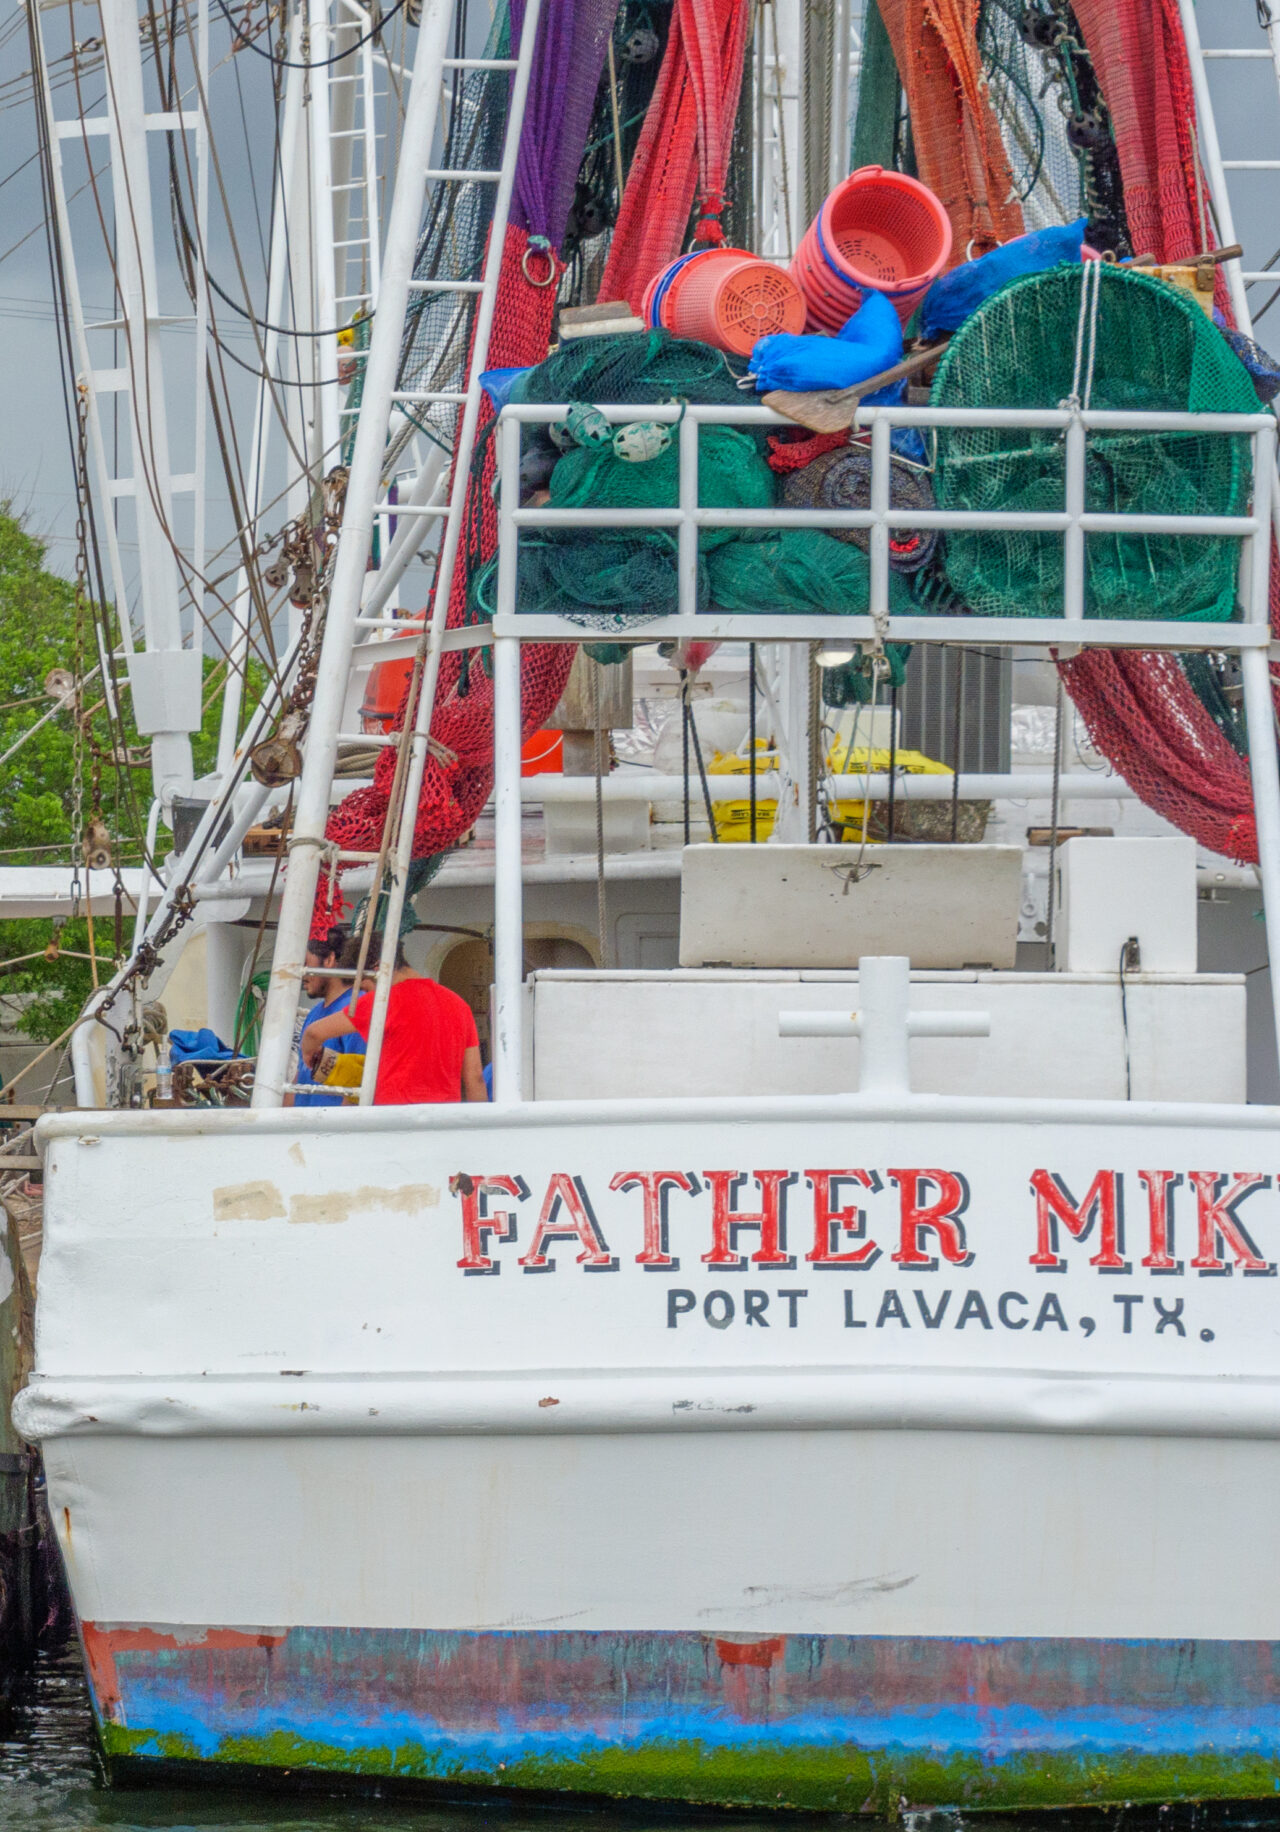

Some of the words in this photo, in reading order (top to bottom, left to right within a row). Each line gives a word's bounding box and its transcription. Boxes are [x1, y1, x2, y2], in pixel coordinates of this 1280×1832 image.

[448, 1169, 976, 1276] FATHER
[1028, 1168, 1280, 1277] MIK
[667, 1289, 808, 1330] PORT
